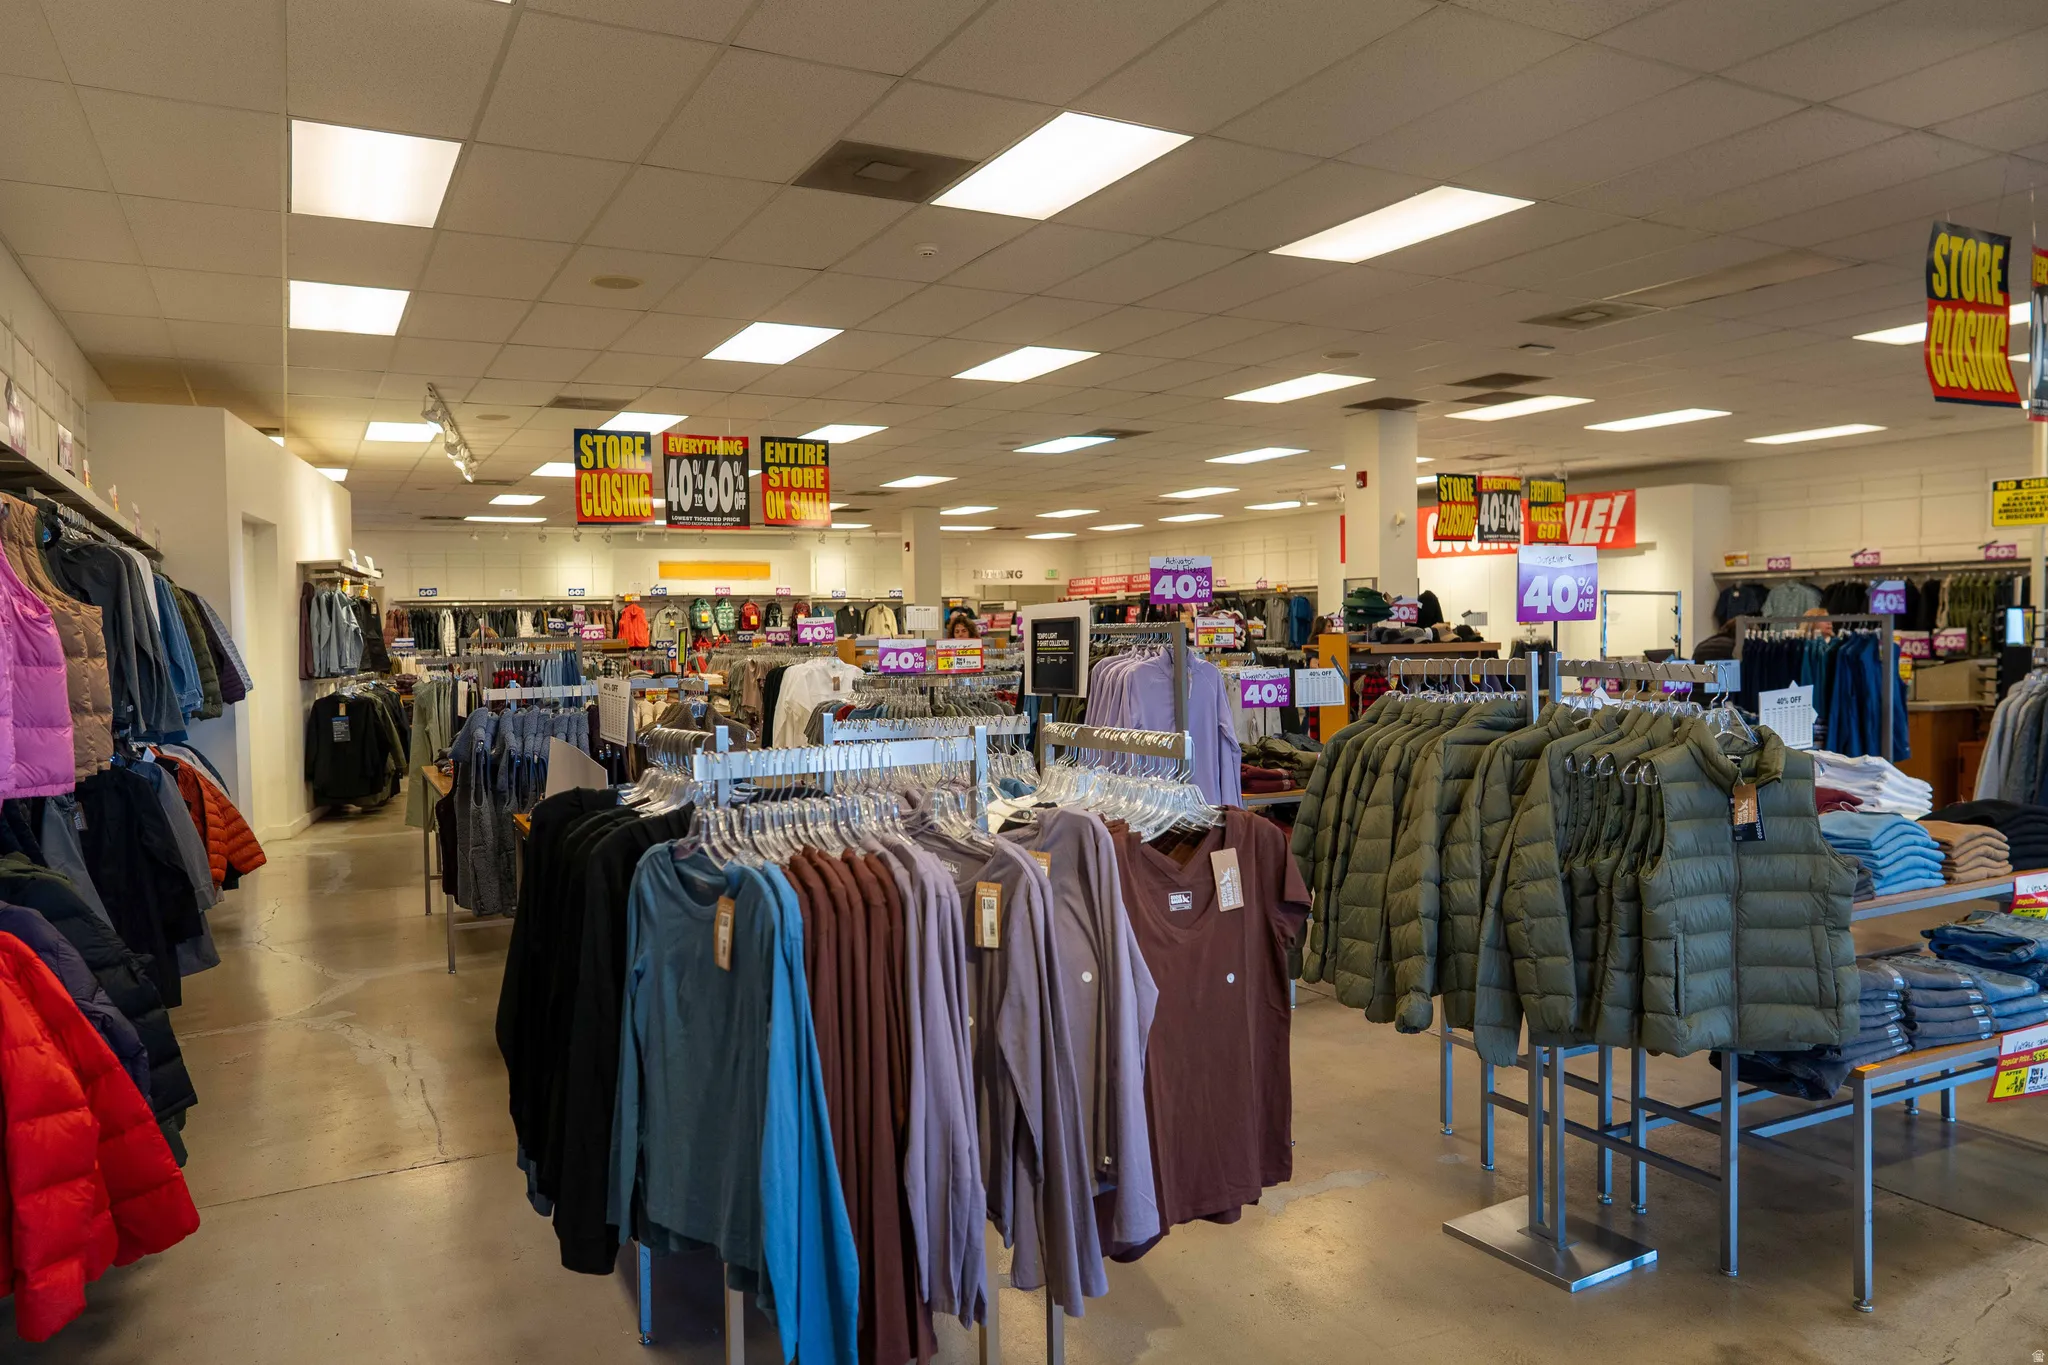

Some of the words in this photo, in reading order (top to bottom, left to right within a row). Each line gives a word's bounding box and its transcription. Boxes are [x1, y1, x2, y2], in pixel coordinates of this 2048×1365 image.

[1932, 232, 2004, 306] STORE
[1930, 305, 2014, 393] CLOSING
[580, 434, 646, 470] STORE
[668, 436, 743, 456] EVERYTHING
[764, 441, 826, 466] ENTIRE
[667, 458, 703, 512] 40%
[694, 493, 703, 506] TO
[704, 459, 744, 514] 60%
[768, 466, 825, 489] STORE
[1997, 480, 2016, 490] NO
[581, 472, 652, 517] CLOSING
[1440, 476, 1474, 502] STORE
[734, 491, 746, 511] OFF
[765, 490, 786, 520] ON
[789, 491, 828, 522] SALE!
[1437, 503, 1476, 536] CLOSING
[1531, 506, 1563, 522] MUST
[1537, 522, 1561, 539] GO!
[1165, 556, 1195, 564] Activator
[973, 569, 1023, 579] FITTING
[1071, 578, 1096, 587] CLEARANCE
[1101, 576, 1128, 585] CLEARANCE
[1154, 574, 1209, 600] 40%
[1196, 588, 1210, 598] OFF
[1523, 573, 1594, 614] 40%
[1577, 598, 1594, 612] OFF
[800, 626, 833, 641] 40%
[882, 652, 924, 669] 40%
[1244, 684, 1287, 704] 40%
[2001, 1058, 2019, 1066] Regular
